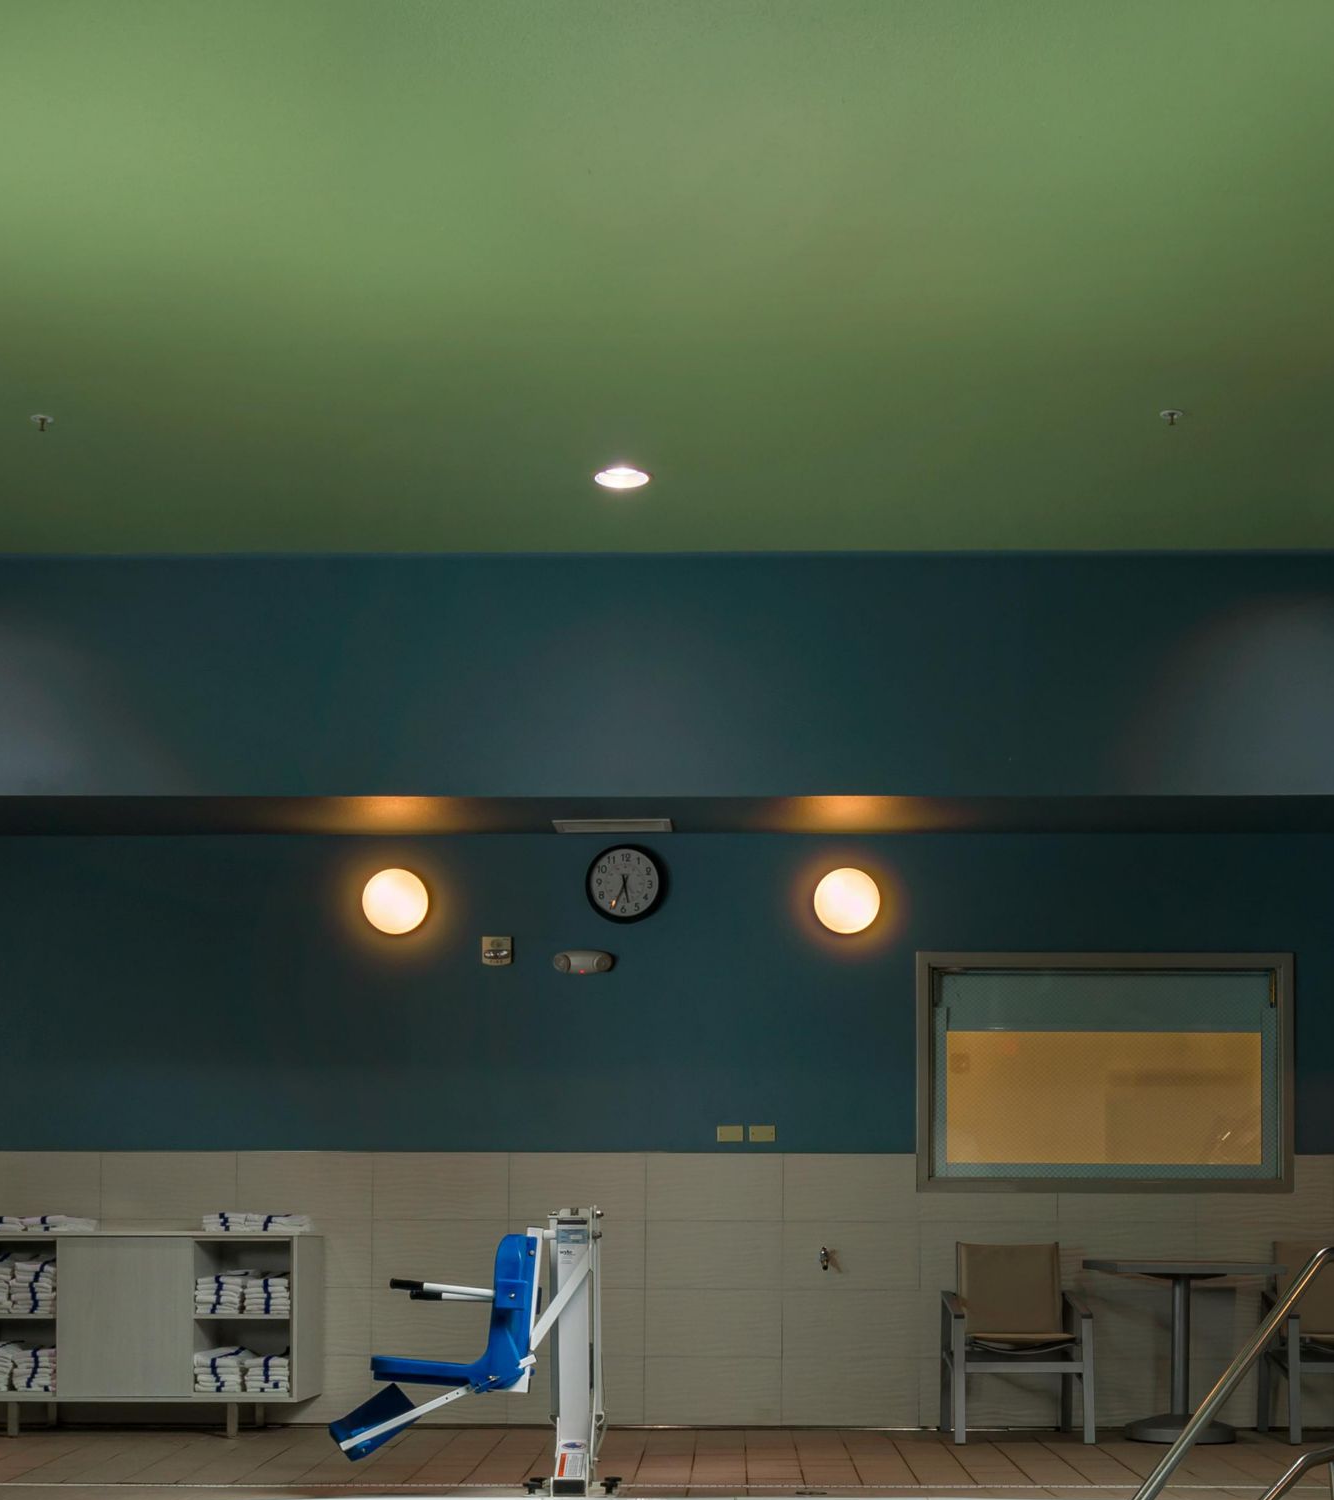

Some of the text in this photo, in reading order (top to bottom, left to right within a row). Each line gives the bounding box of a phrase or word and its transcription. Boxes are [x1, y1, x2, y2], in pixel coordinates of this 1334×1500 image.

[608, 856, 616, 864] 11
[621, 853, 631, 862] 12
[598, 864, 608, 874] 10
[596, 878, 603, 887] 9
[647, 880, 653, 889] 3
[598, 891, 605, 900] 8
[620, 905, 627, 914] 6
[635, 902, 641, 912] 5
